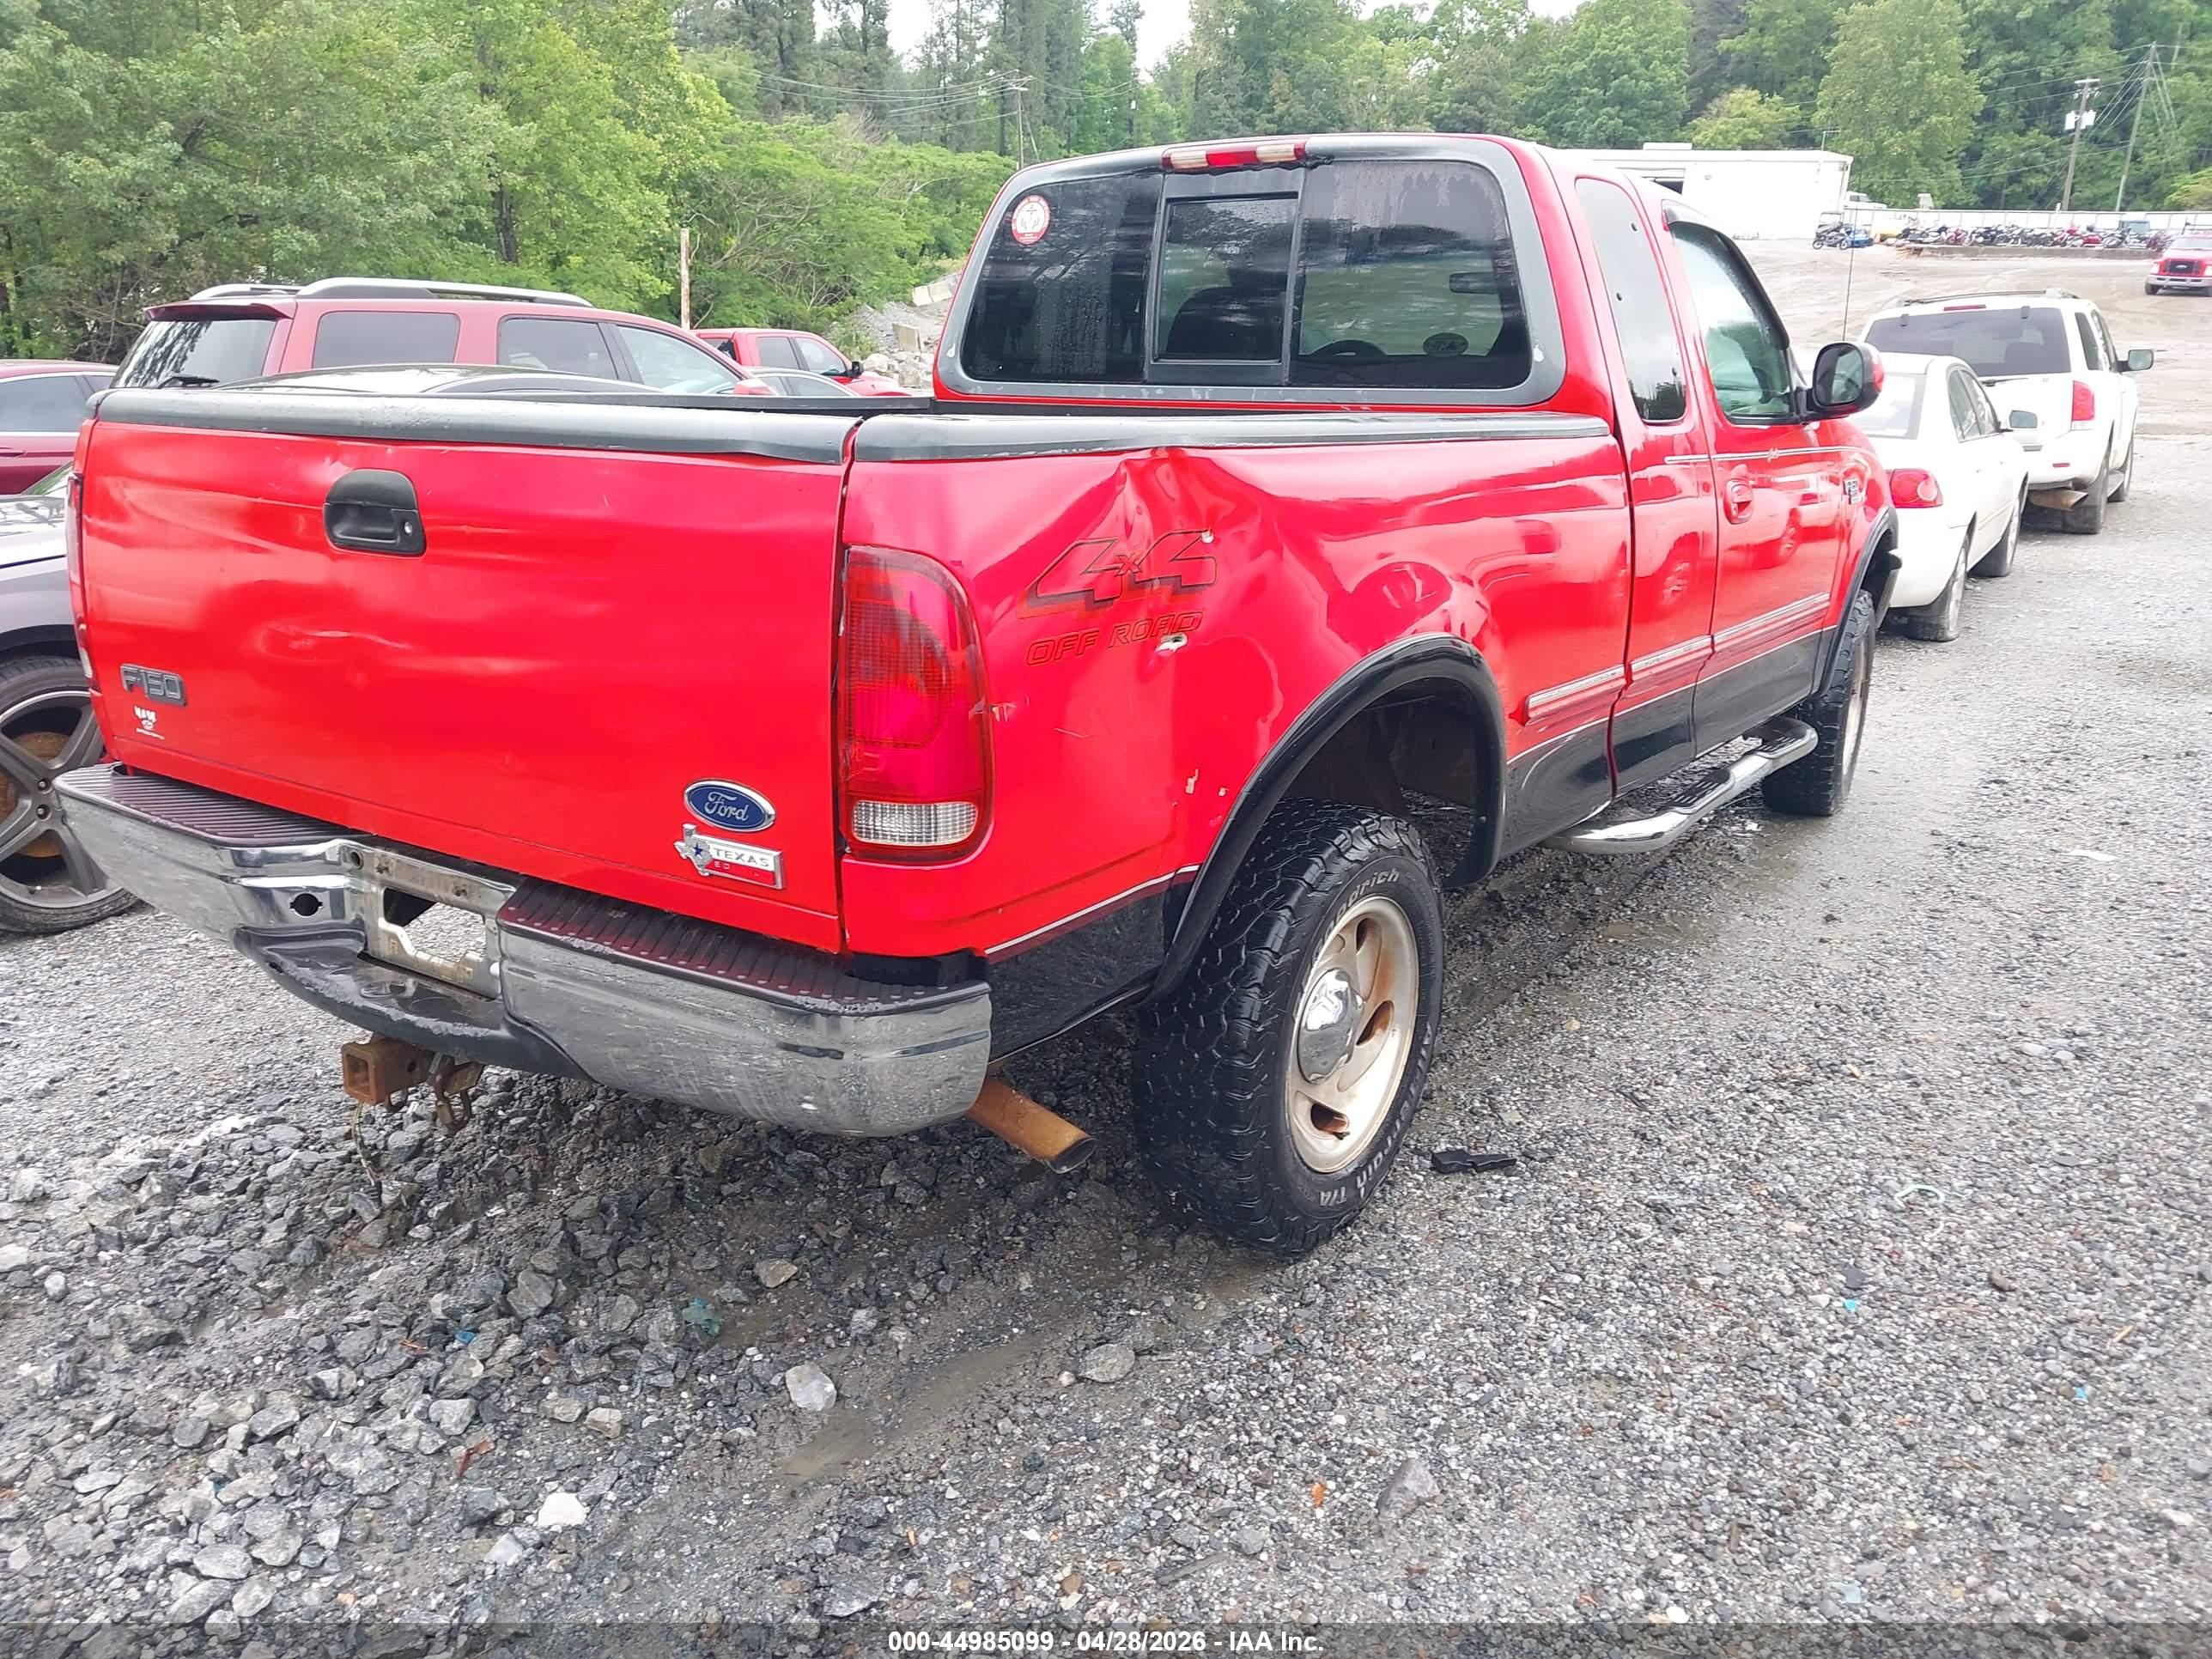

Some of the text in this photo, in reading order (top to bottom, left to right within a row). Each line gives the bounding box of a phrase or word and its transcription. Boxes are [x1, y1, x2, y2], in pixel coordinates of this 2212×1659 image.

[1025, 611, 1204, 665] OFF ROAD
[704, 790, 750, 821] Ford
[714, 847, 769, 867] TEXAS
